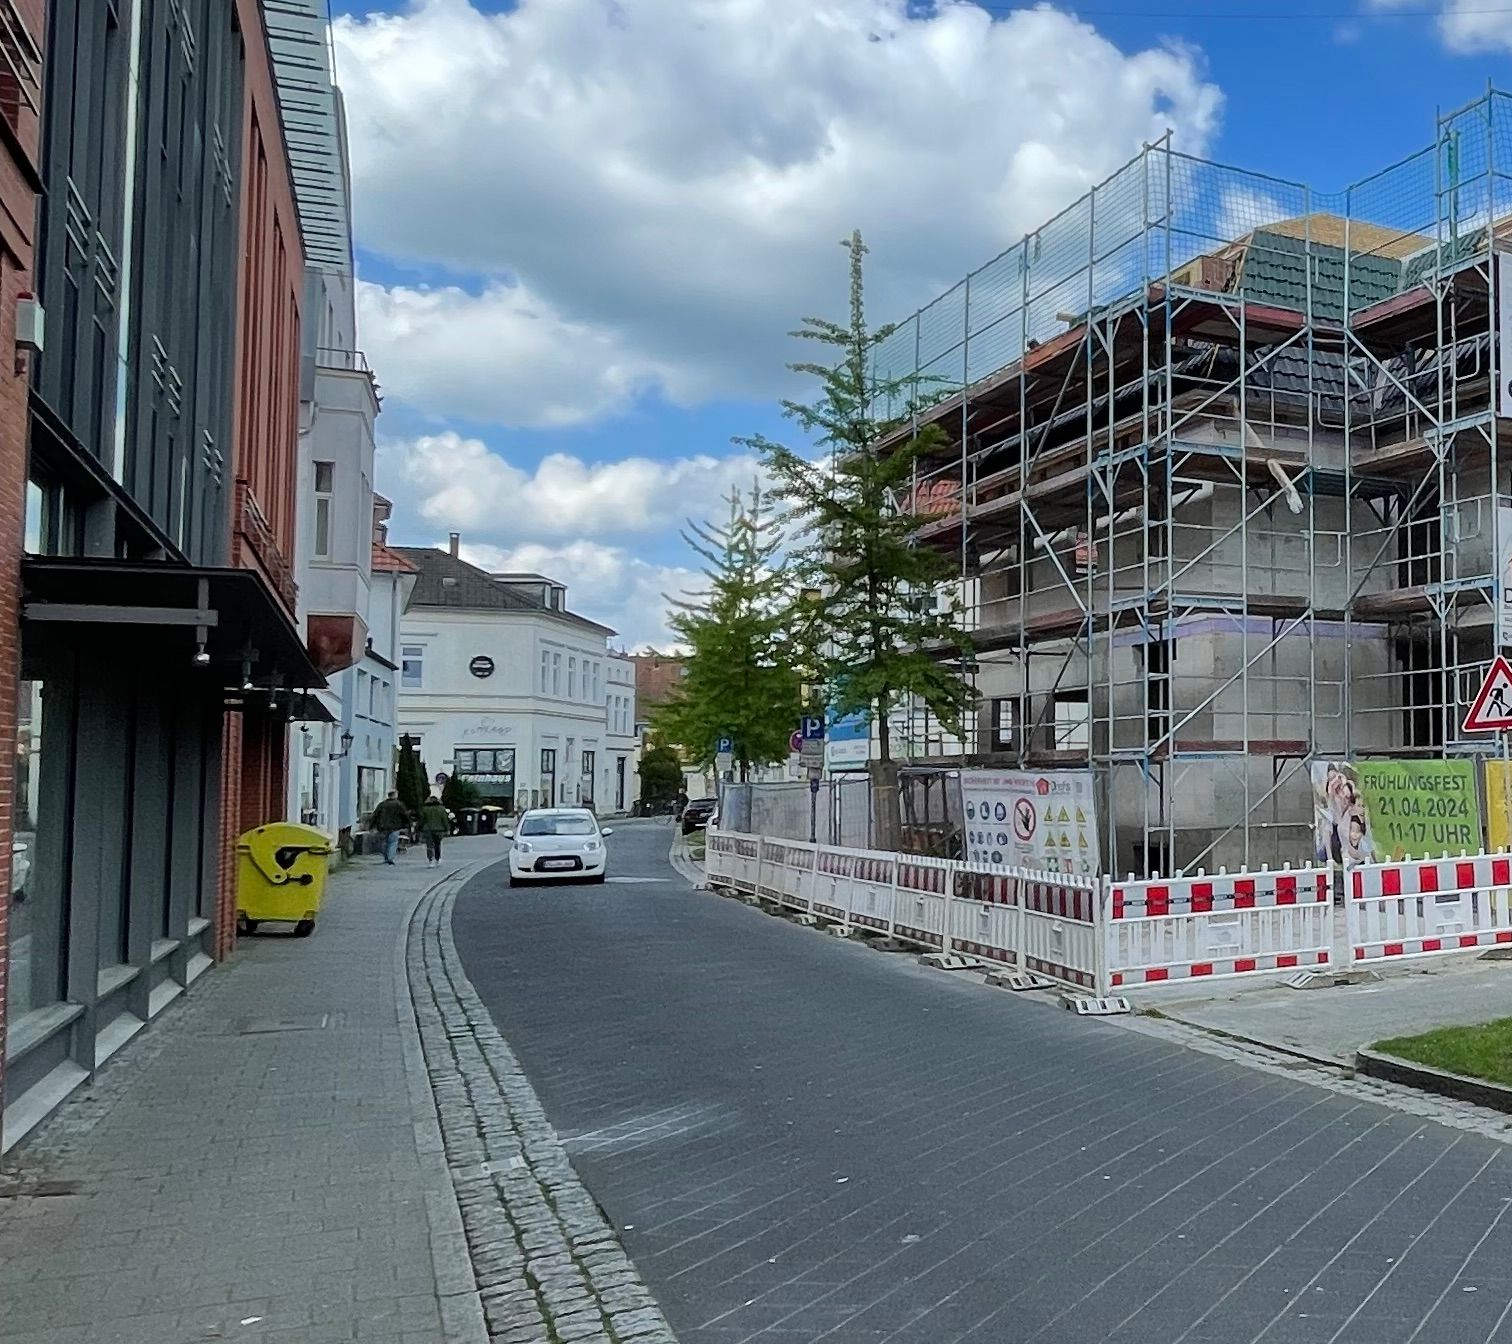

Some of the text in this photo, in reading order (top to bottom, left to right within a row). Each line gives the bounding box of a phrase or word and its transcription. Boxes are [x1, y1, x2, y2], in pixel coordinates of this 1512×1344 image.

[1363, 771, 1468, 792] FRÜHLINGSFEST
[1378, 796, 1469, 818] 21.04.2024
[1388, 822, 1473, 844] 11-17 UHR
